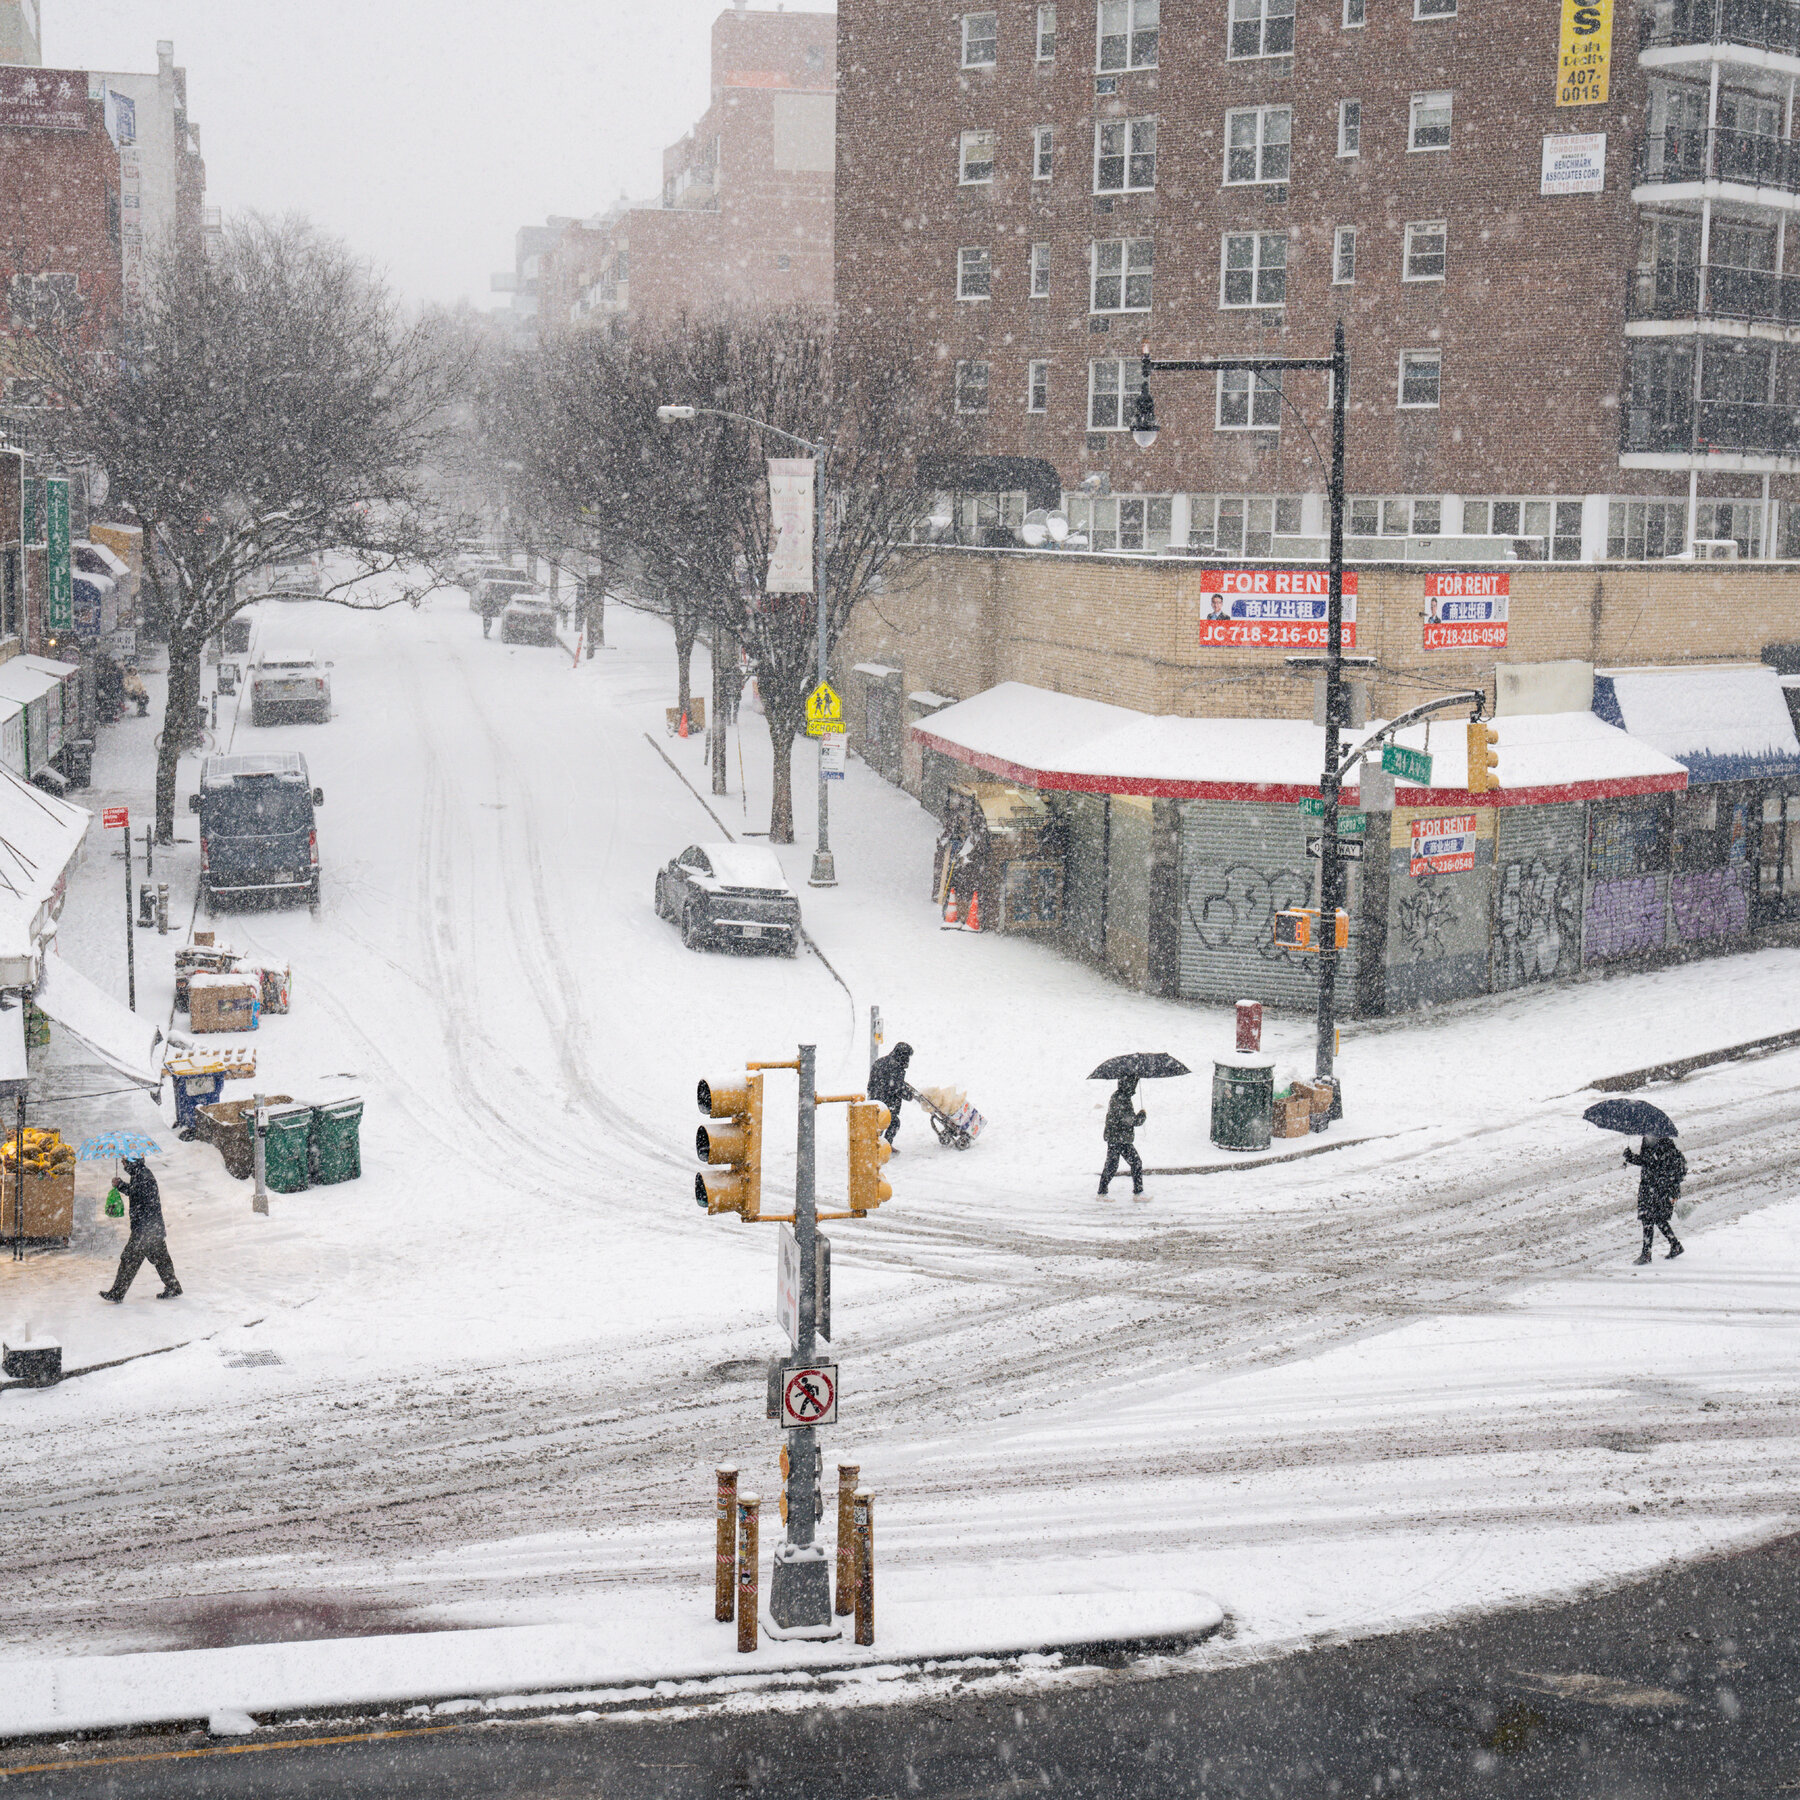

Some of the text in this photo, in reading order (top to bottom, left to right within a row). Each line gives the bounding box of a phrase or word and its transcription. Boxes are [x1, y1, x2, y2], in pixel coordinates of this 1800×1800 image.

[1568, 69, 1601, 86] 407-
[1562, 85, 1600, 102] 0015
[1554, 158, 1592, 170] BENCHMARK
[1546, 168, 1601, 181] ASSOCIATES CORP.
[1221, 573, 1269, 593] FOR
[1436, 575, 1499, 595] FOR RENT
[1246, 600, 1315, 618] 商业出租
[1449, 602, 1486, 620] 商业出租
[1202, 625, 1351, 643] JC 718-216-058
[1425, 628, 1506, 645] JC 718-216-0548
[810, 723, 842, 734] SCHOOL
[1420, 816, 1472, 836] FOR RENT
[1410, 862, 1422, 876] JC
